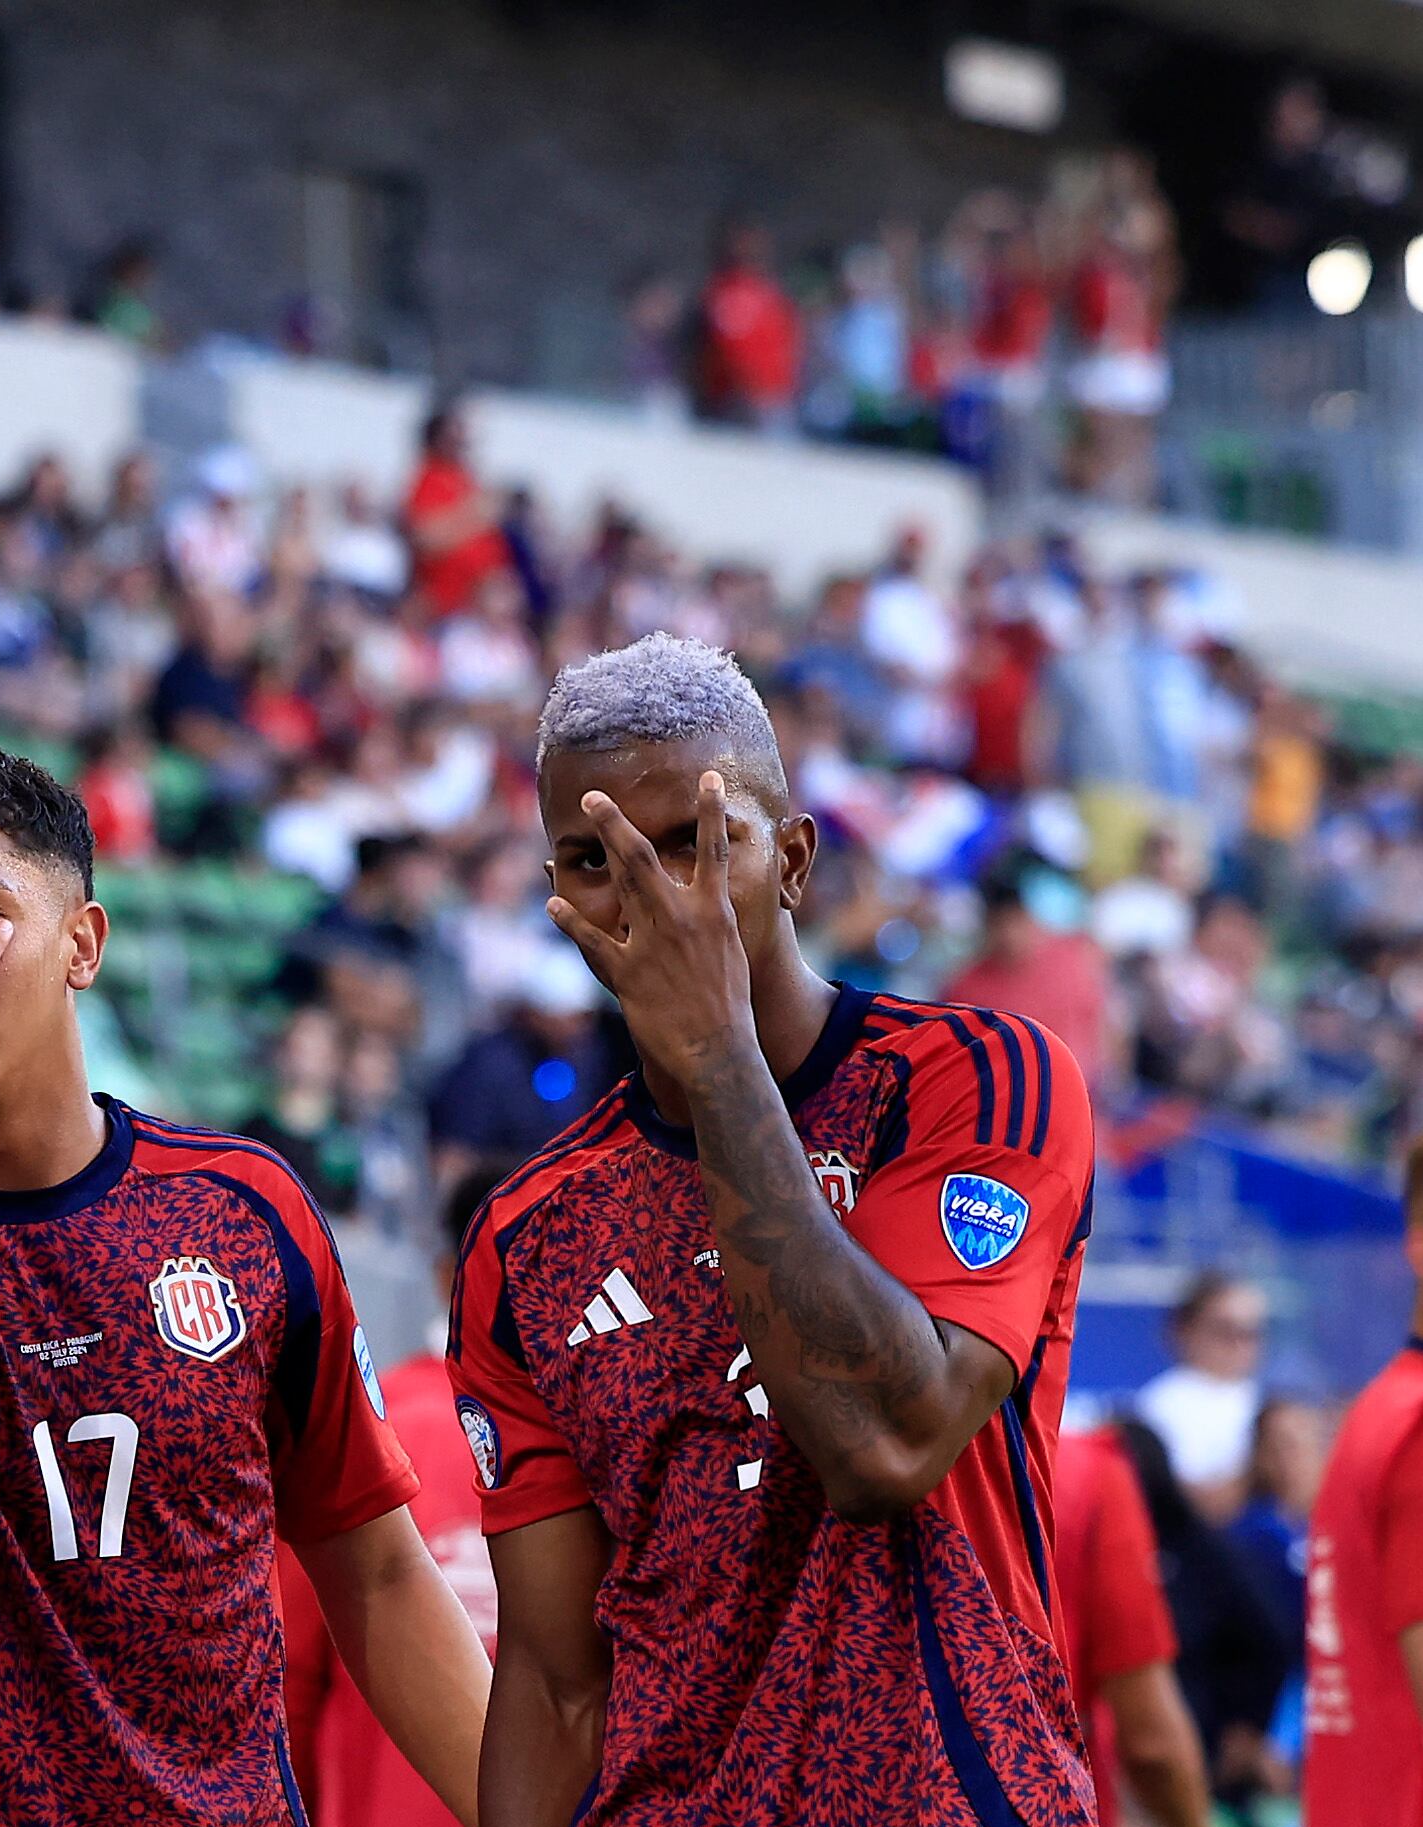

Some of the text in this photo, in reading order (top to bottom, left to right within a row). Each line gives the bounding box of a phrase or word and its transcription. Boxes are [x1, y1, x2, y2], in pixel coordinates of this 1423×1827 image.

[822, 1174, 849, 1222] R
[951, 1195, 1017, 1230] VIBRA
[949, 1211, 1013, 1237] EL CONTINENTE
[169, 1280, 224, 1342] CR
[20, 1343, 42, 1354] COSTA
[42, 1340, 59, 1351] RICA
[66, 1331, 103, 1346] PARAGUAY
[39, 1352, 50, 1361] 02
[50, 1347, 68, 1359] JULY
[53, 1356, 79, 1369] AUSTIN
[32, 1412, 139, 1561] 17
